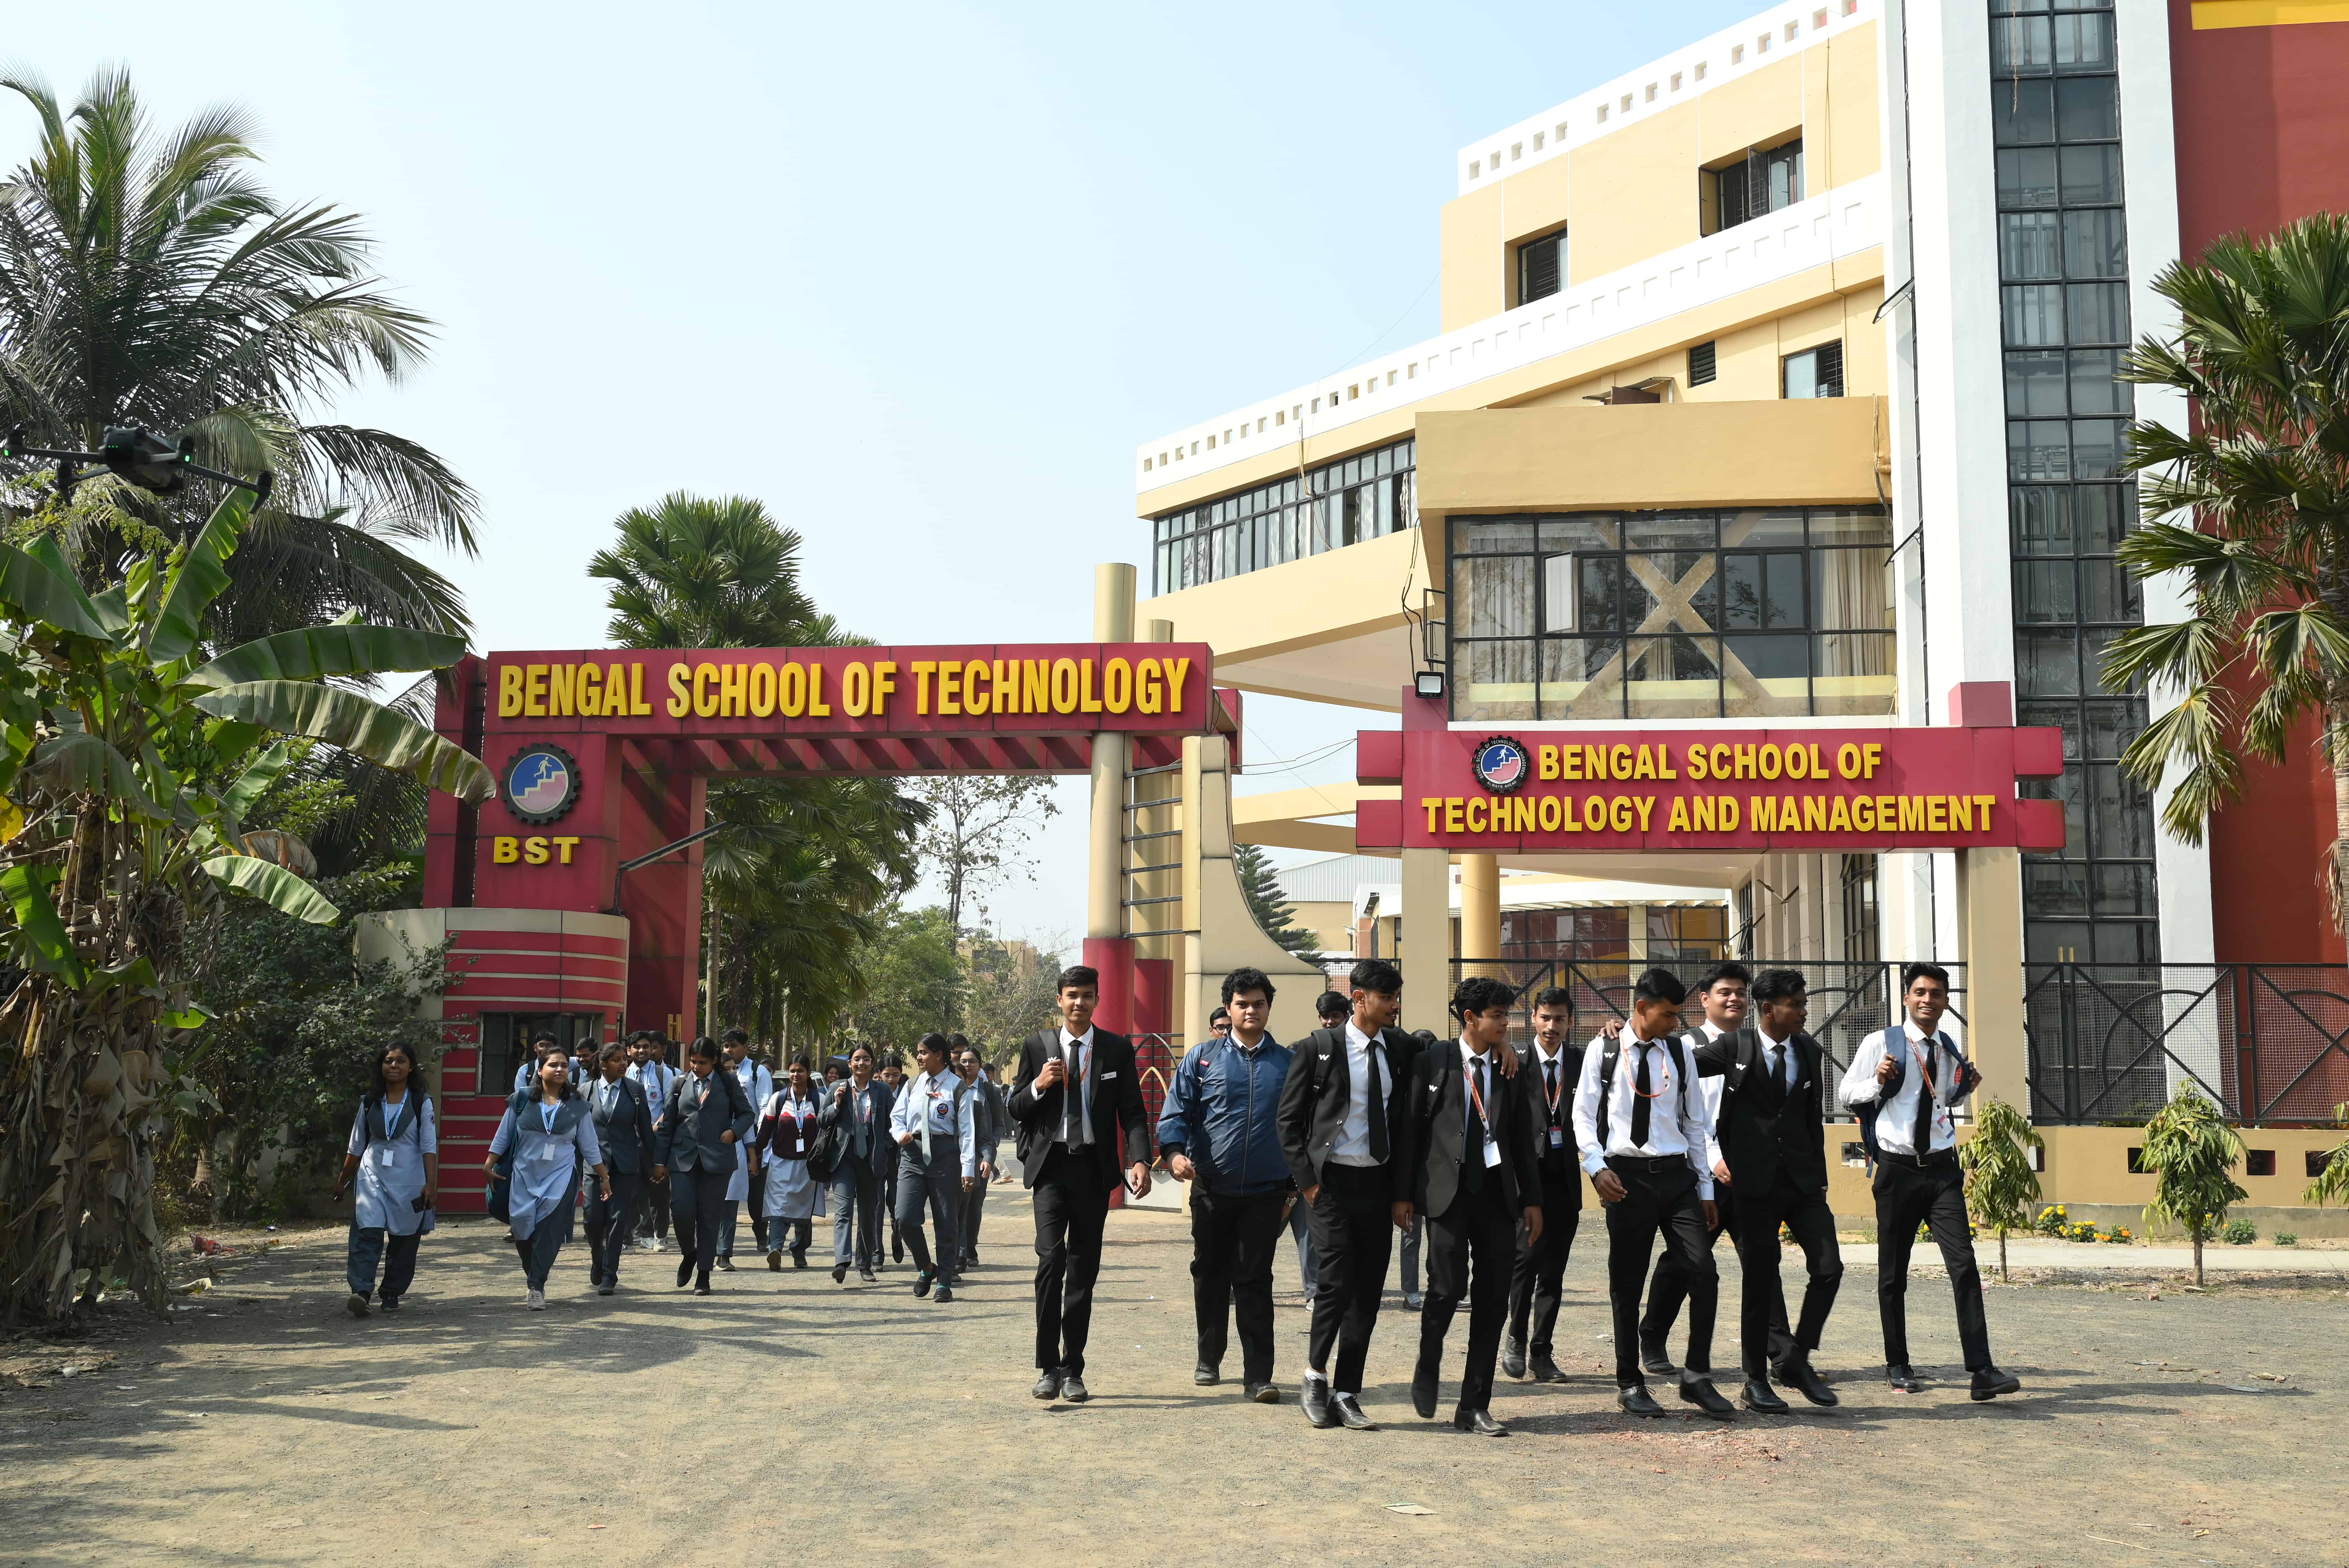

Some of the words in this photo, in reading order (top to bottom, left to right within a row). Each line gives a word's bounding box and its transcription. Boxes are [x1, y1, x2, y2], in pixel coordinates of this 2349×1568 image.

[499, 663, 652, 718] BENGAL
[668, 662, 831, 718] SCHOOL
[843, 661, 897, 717] OF
[912, 657, 1190, 716] TECHNOLOGY
[1476, 748, 1485, 762] SCHOOL
[1492, 739, 1516, 748] TECHNOLOGY
[1540, 744, 1677, 780] BENGAL
[1688, 743, 1829, 780] SCHOOL
[1838, 743, 1882, 779] OF
[1422, 795, 1656, 833] TECHNOLOGY
[1668, 796, 1740, 832] AND
[1751, 795, 1996, 832] MANAGEMENT
[493, 836, 581, 864] BST
